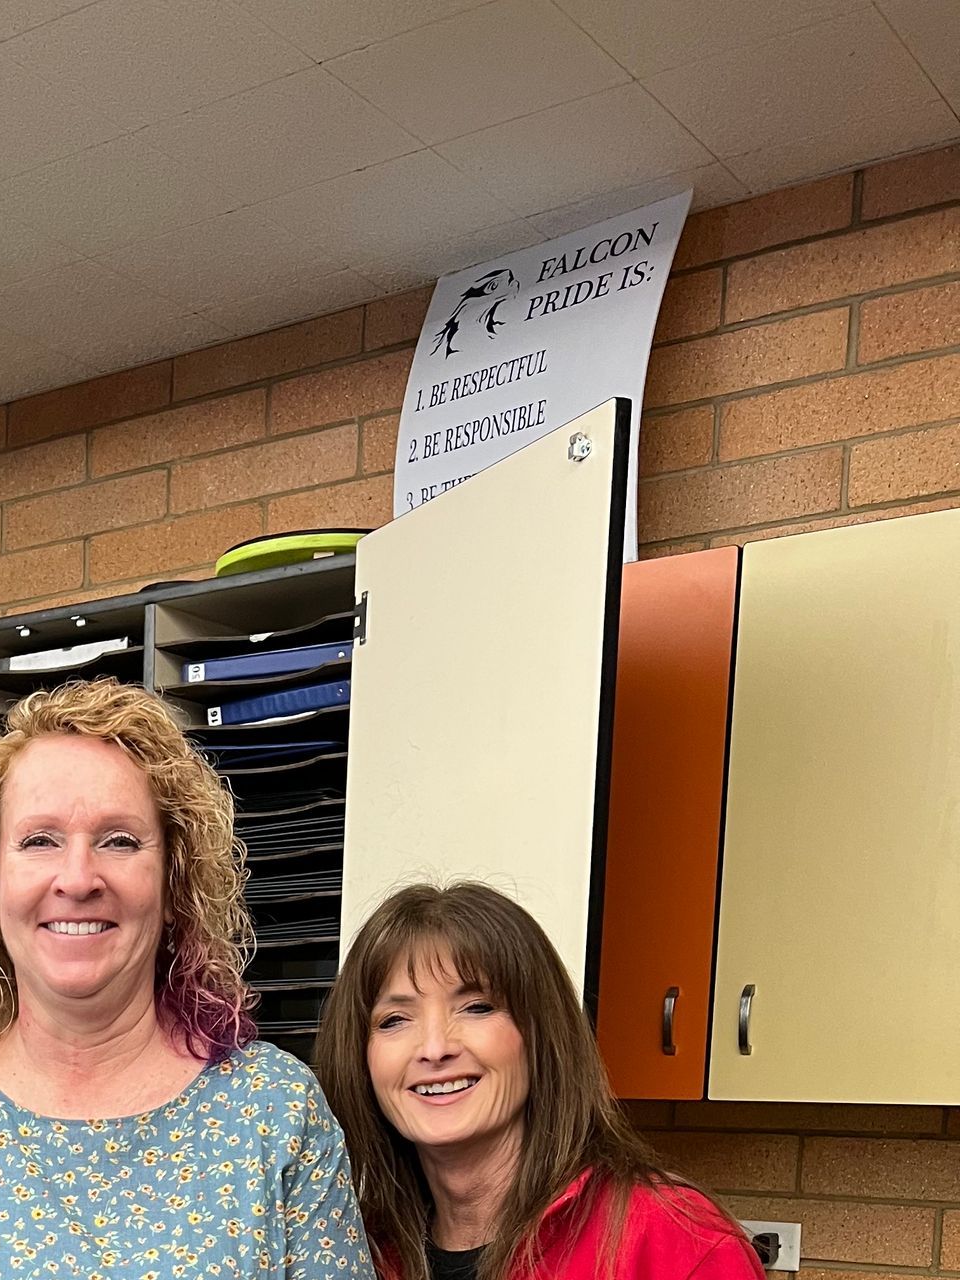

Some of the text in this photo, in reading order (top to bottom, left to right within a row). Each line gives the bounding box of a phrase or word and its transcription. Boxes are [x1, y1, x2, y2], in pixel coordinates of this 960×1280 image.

[535, 221, 660, 284] FALCON
[523, 259, 655, 322] PRIDE IS:
[414, 349, 548, 413] 1. BE RESPECTFUL
[407, 399, 547, 464] 2. BE RESPONSIBLE
[211, 710, 218, 723] 16
